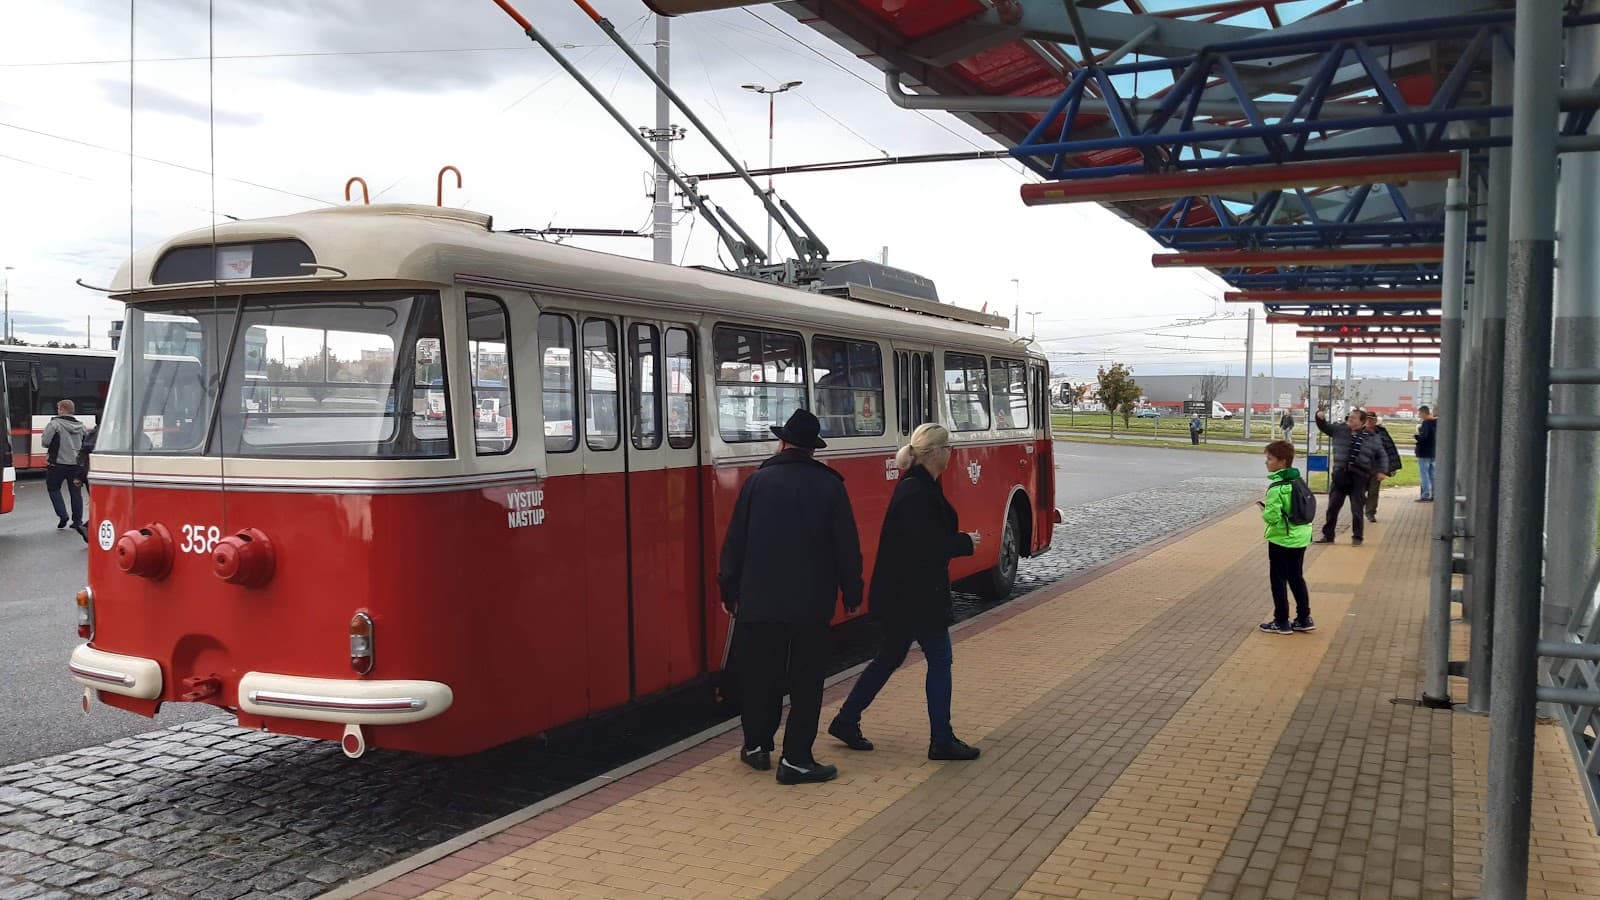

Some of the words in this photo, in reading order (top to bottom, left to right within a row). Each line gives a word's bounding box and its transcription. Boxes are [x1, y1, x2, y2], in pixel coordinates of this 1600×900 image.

[507, 489, 544, 508] VÝSTUP
[101, 523, 112, 538] 65
[181, 524, 220, 554] 358
